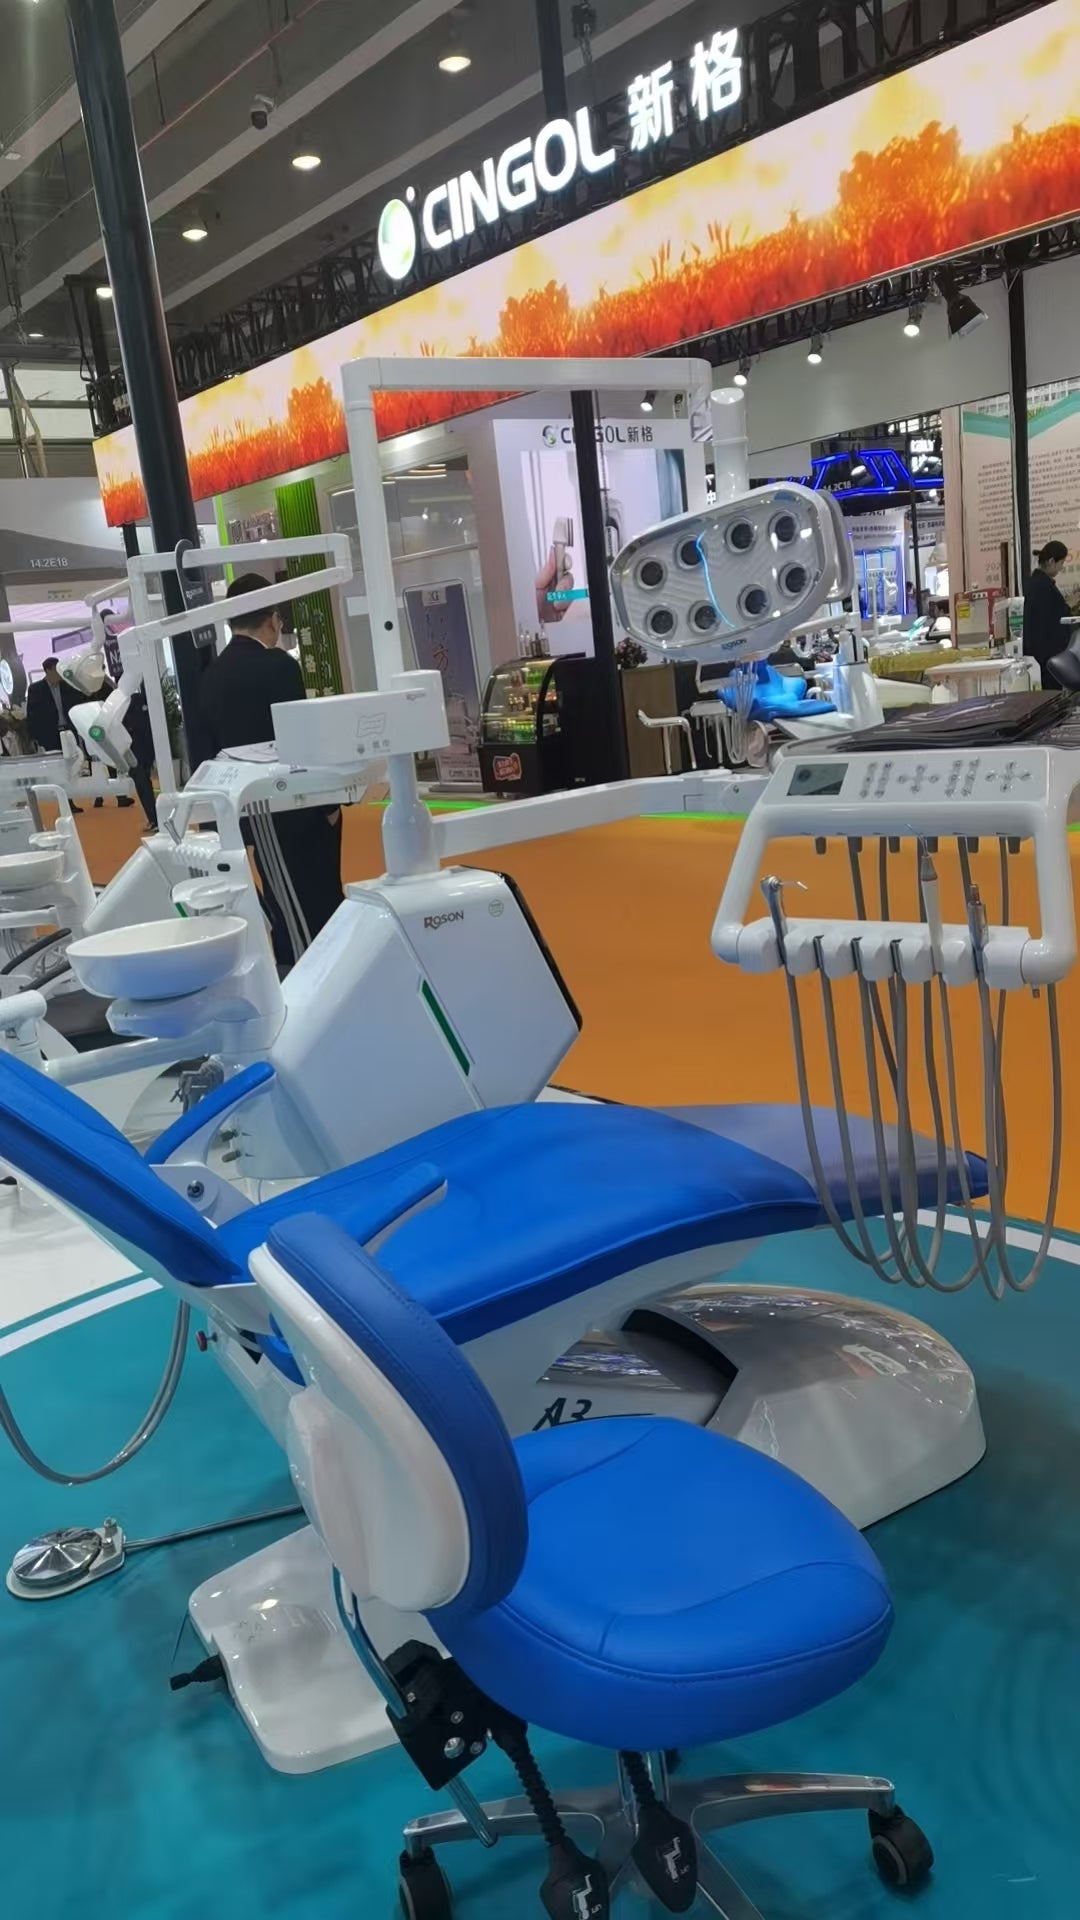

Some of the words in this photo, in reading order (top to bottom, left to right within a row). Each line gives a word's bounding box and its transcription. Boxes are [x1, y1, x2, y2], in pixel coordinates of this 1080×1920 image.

[422, 106, 617, 250] CINGOL
[627, 27, 743, 151] 新格
[627, 426, 653, 443] 新格
[30, 557, 68, 568] 14.2E18
[424, 910, 464, 930] ROSON
[532, 1397, 593, 1431] A3
